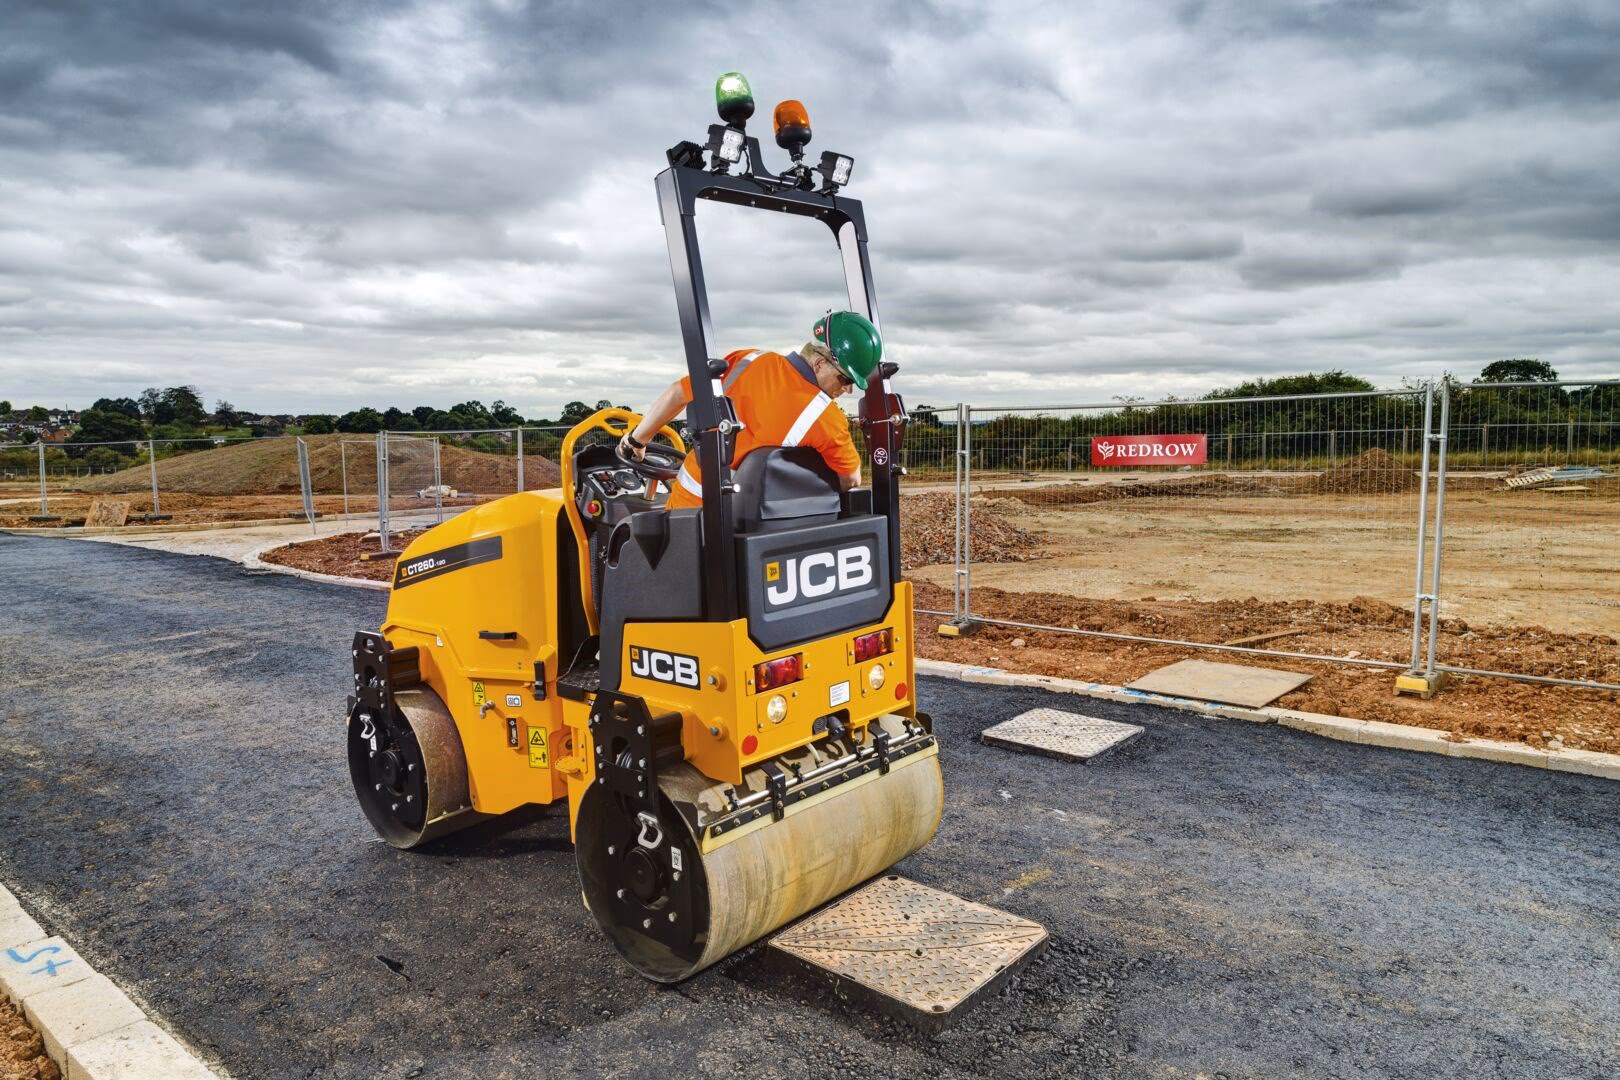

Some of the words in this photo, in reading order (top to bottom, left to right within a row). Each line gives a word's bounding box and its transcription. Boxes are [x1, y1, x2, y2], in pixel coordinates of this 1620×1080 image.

[1116, 443, 1198, 457] REDROW
[767, 545, 873, 606] JCB
[632, 649, 699, 686] JCB
